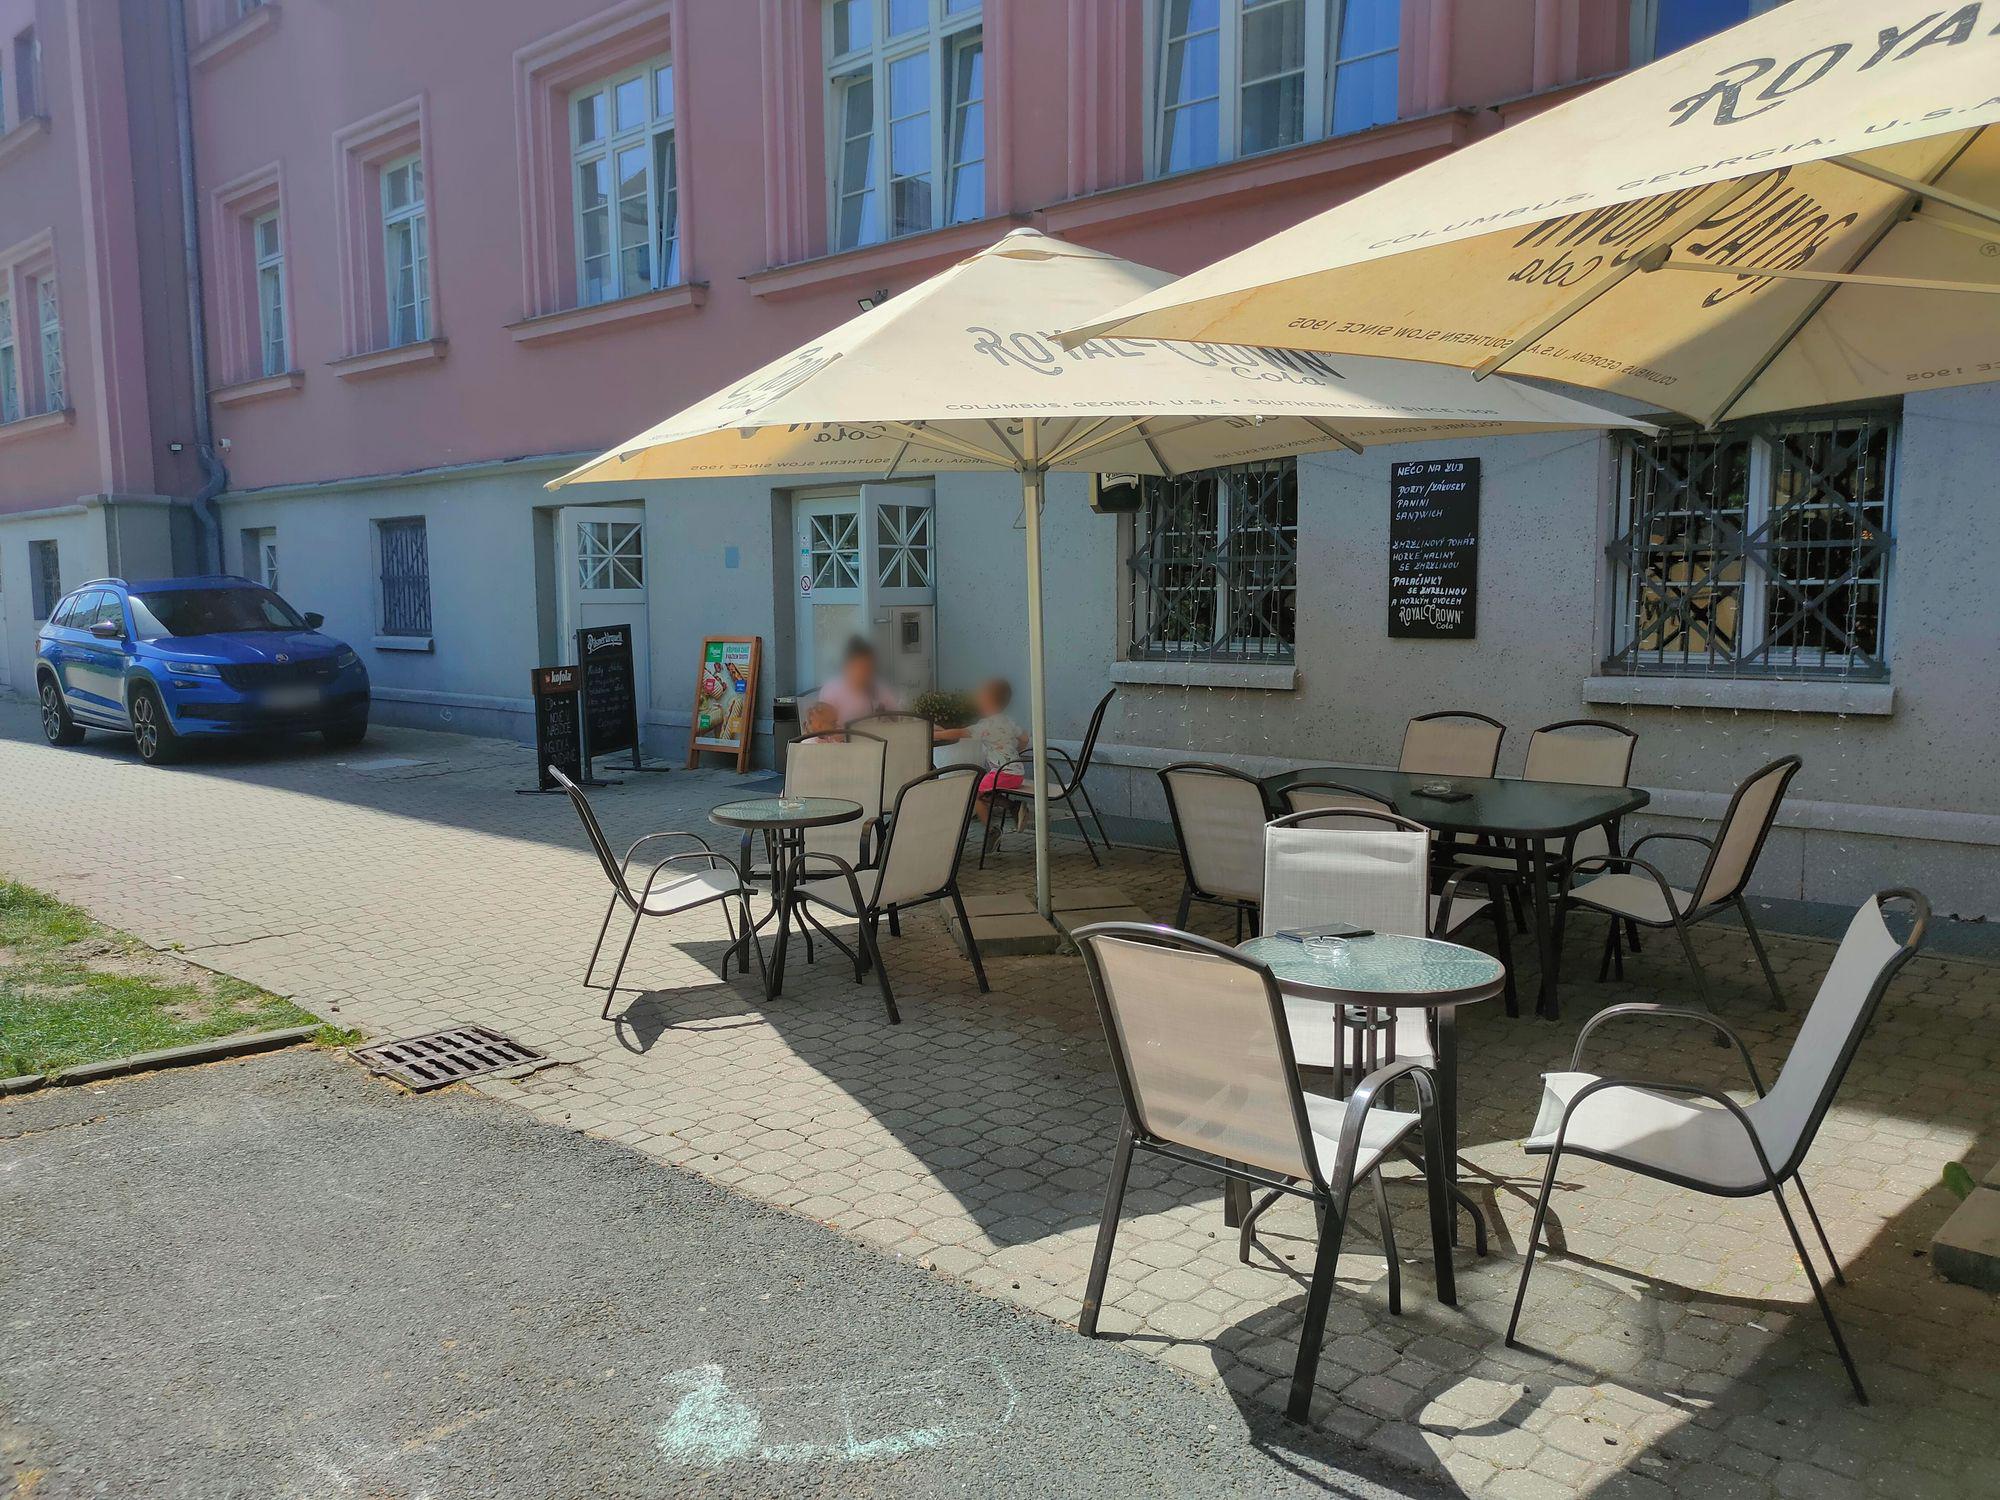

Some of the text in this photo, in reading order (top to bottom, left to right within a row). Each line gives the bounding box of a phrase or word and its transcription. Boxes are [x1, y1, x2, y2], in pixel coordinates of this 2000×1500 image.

[1669, 2, 2000, 126] ROYA
[1230, 365, 1327, 387] Cola
[1427, 464, 1441, 473] NA
[1396, 499, 1430, 509] PANINI
[1395, 509, 1444, 522] SANDWICH
[1399, 563, 1410, 571] SE
[1391, 598, 1398, 607] A
[1432, 597, 1462, 605] OVOCEM
